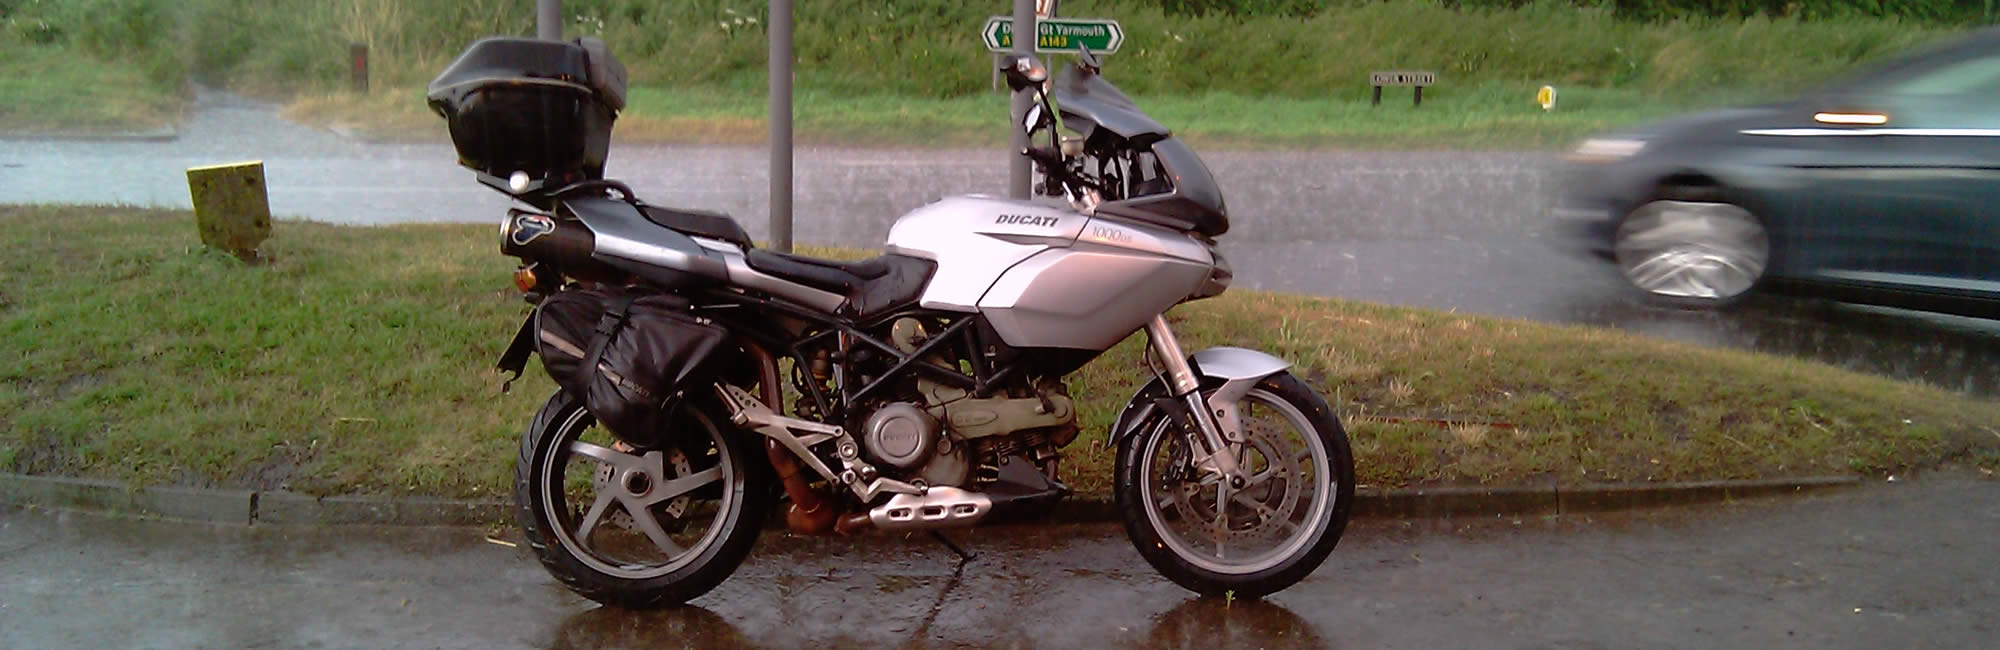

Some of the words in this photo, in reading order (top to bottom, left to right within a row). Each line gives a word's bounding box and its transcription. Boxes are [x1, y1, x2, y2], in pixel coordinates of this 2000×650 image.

[1040, 23, 1054, 35] Gt
[1056, 24, 1105, 37] Yarmouth
[1040, 35, 1068, 47] A143
[995, 214, 1059, 227] DUCATI
